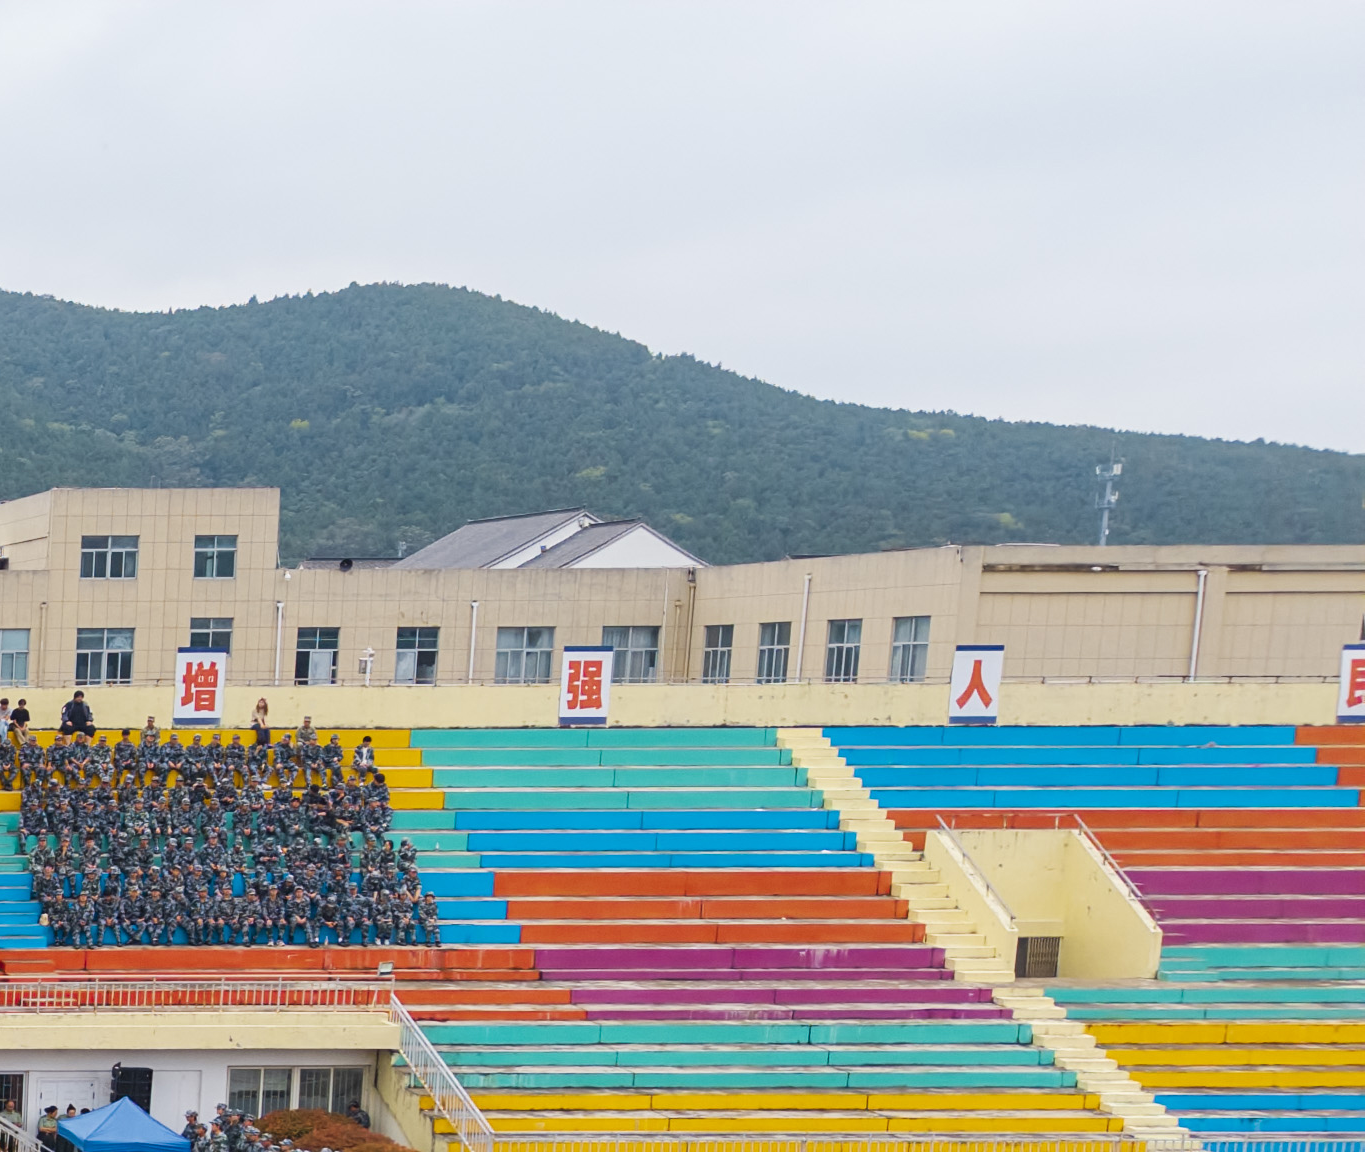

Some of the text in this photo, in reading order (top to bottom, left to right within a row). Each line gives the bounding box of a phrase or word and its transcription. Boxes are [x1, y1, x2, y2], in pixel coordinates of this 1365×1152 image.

[180, 662, 218, 711] 增
[567, 660, 603, 710] 强
[956, 660, 992, 708] 人
